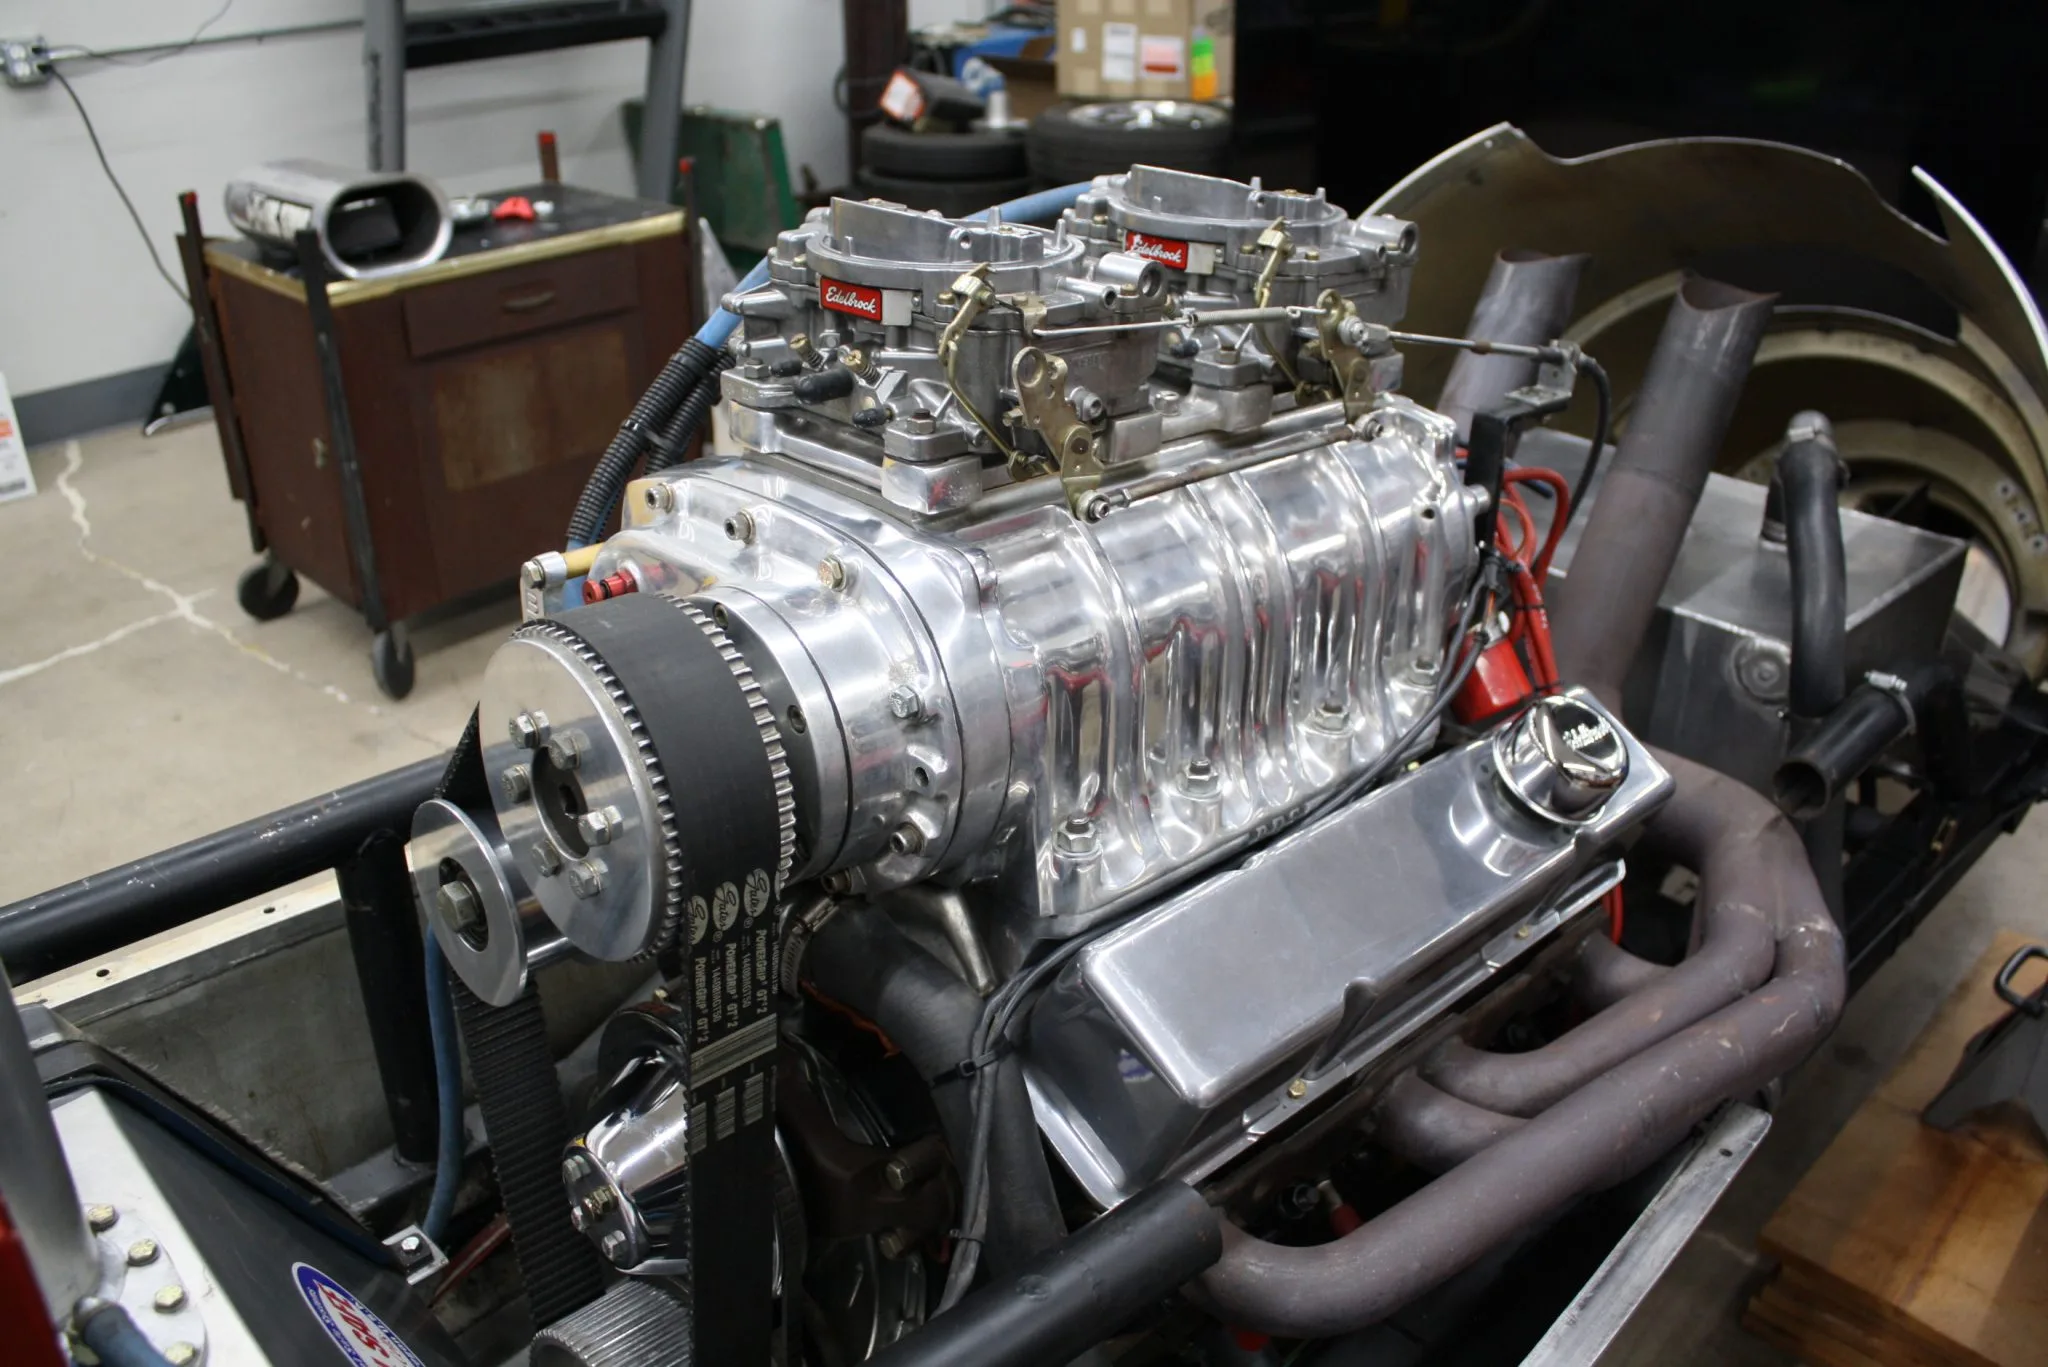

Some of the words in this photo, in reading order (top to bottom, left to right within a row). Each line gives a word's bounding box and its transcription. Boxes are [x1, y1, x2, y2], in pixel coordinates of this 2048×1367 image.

[1128, 233, 1182, 263] Edelbrock
[825, 285, 877, 314] Edelbrock
[714, 886, 738, 931] Gates
[745, 873, 768, 917] Gates
